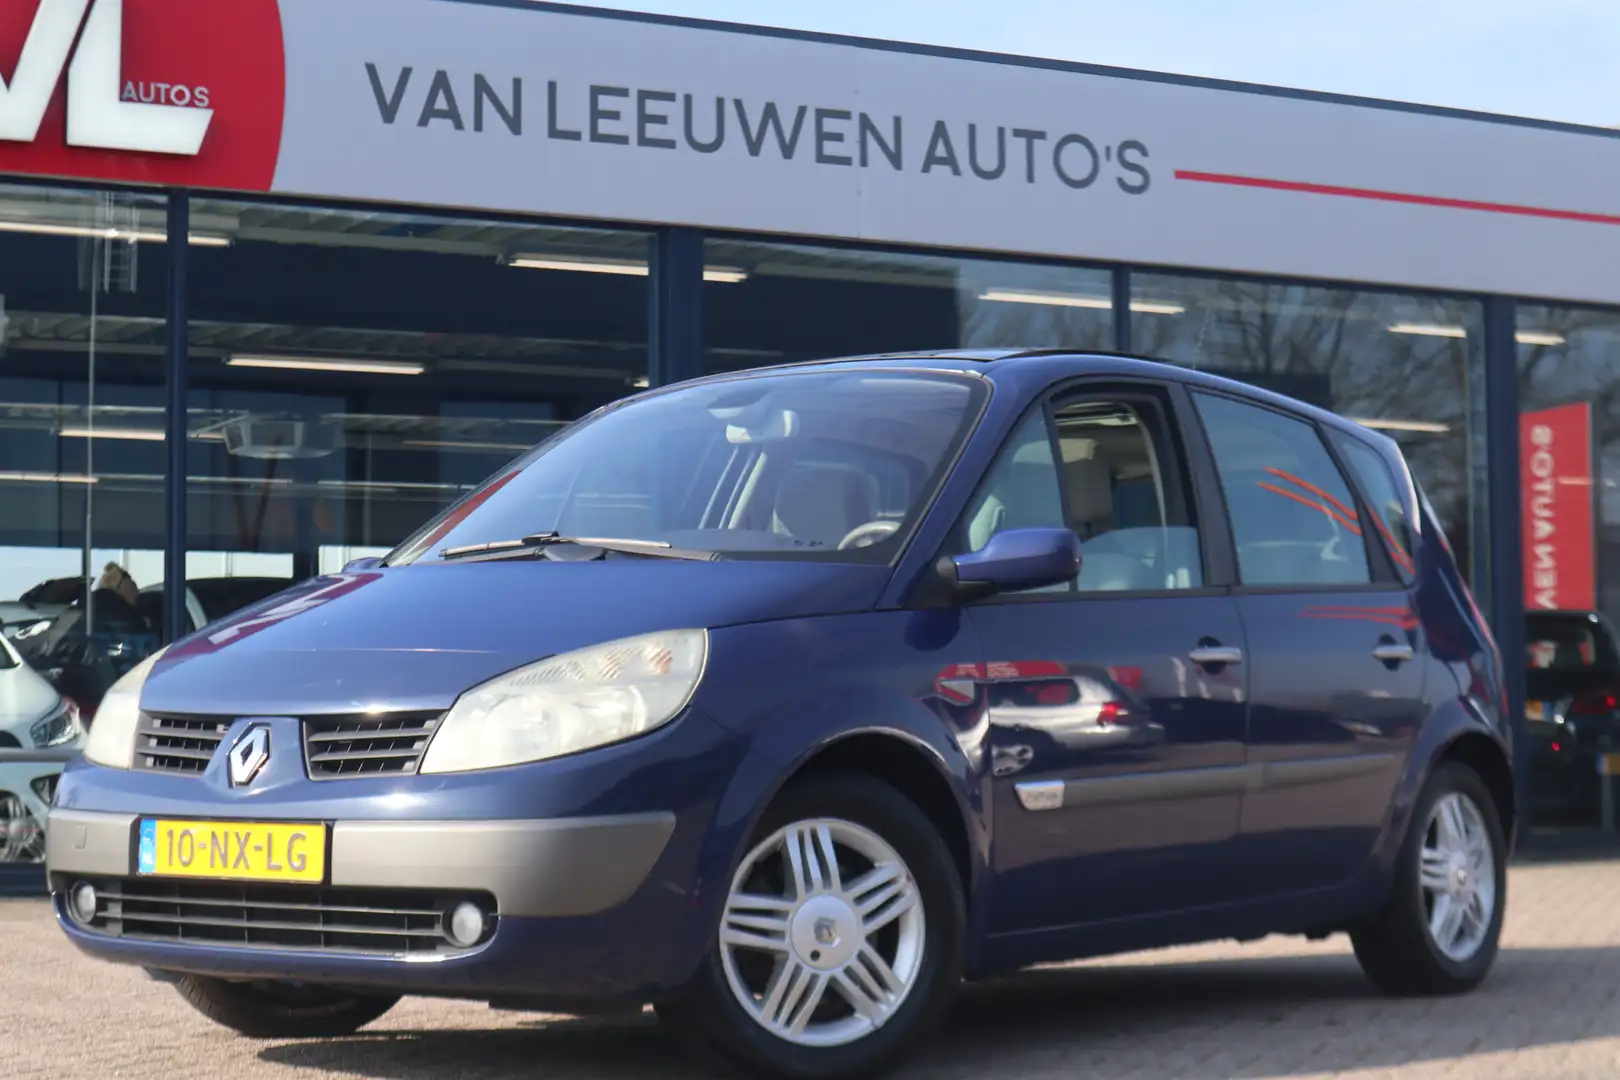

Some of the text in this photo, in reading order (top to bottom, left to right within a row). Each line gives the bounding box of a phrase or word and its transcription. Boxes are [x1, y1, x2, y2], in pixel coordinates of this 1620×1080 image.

[122, 80, 209, 107] AUTOS
[364, 62, 1151, 195] VAN LEEUWEN AUTO'S
[167, 829, 307, 872] 10-NX-LG
